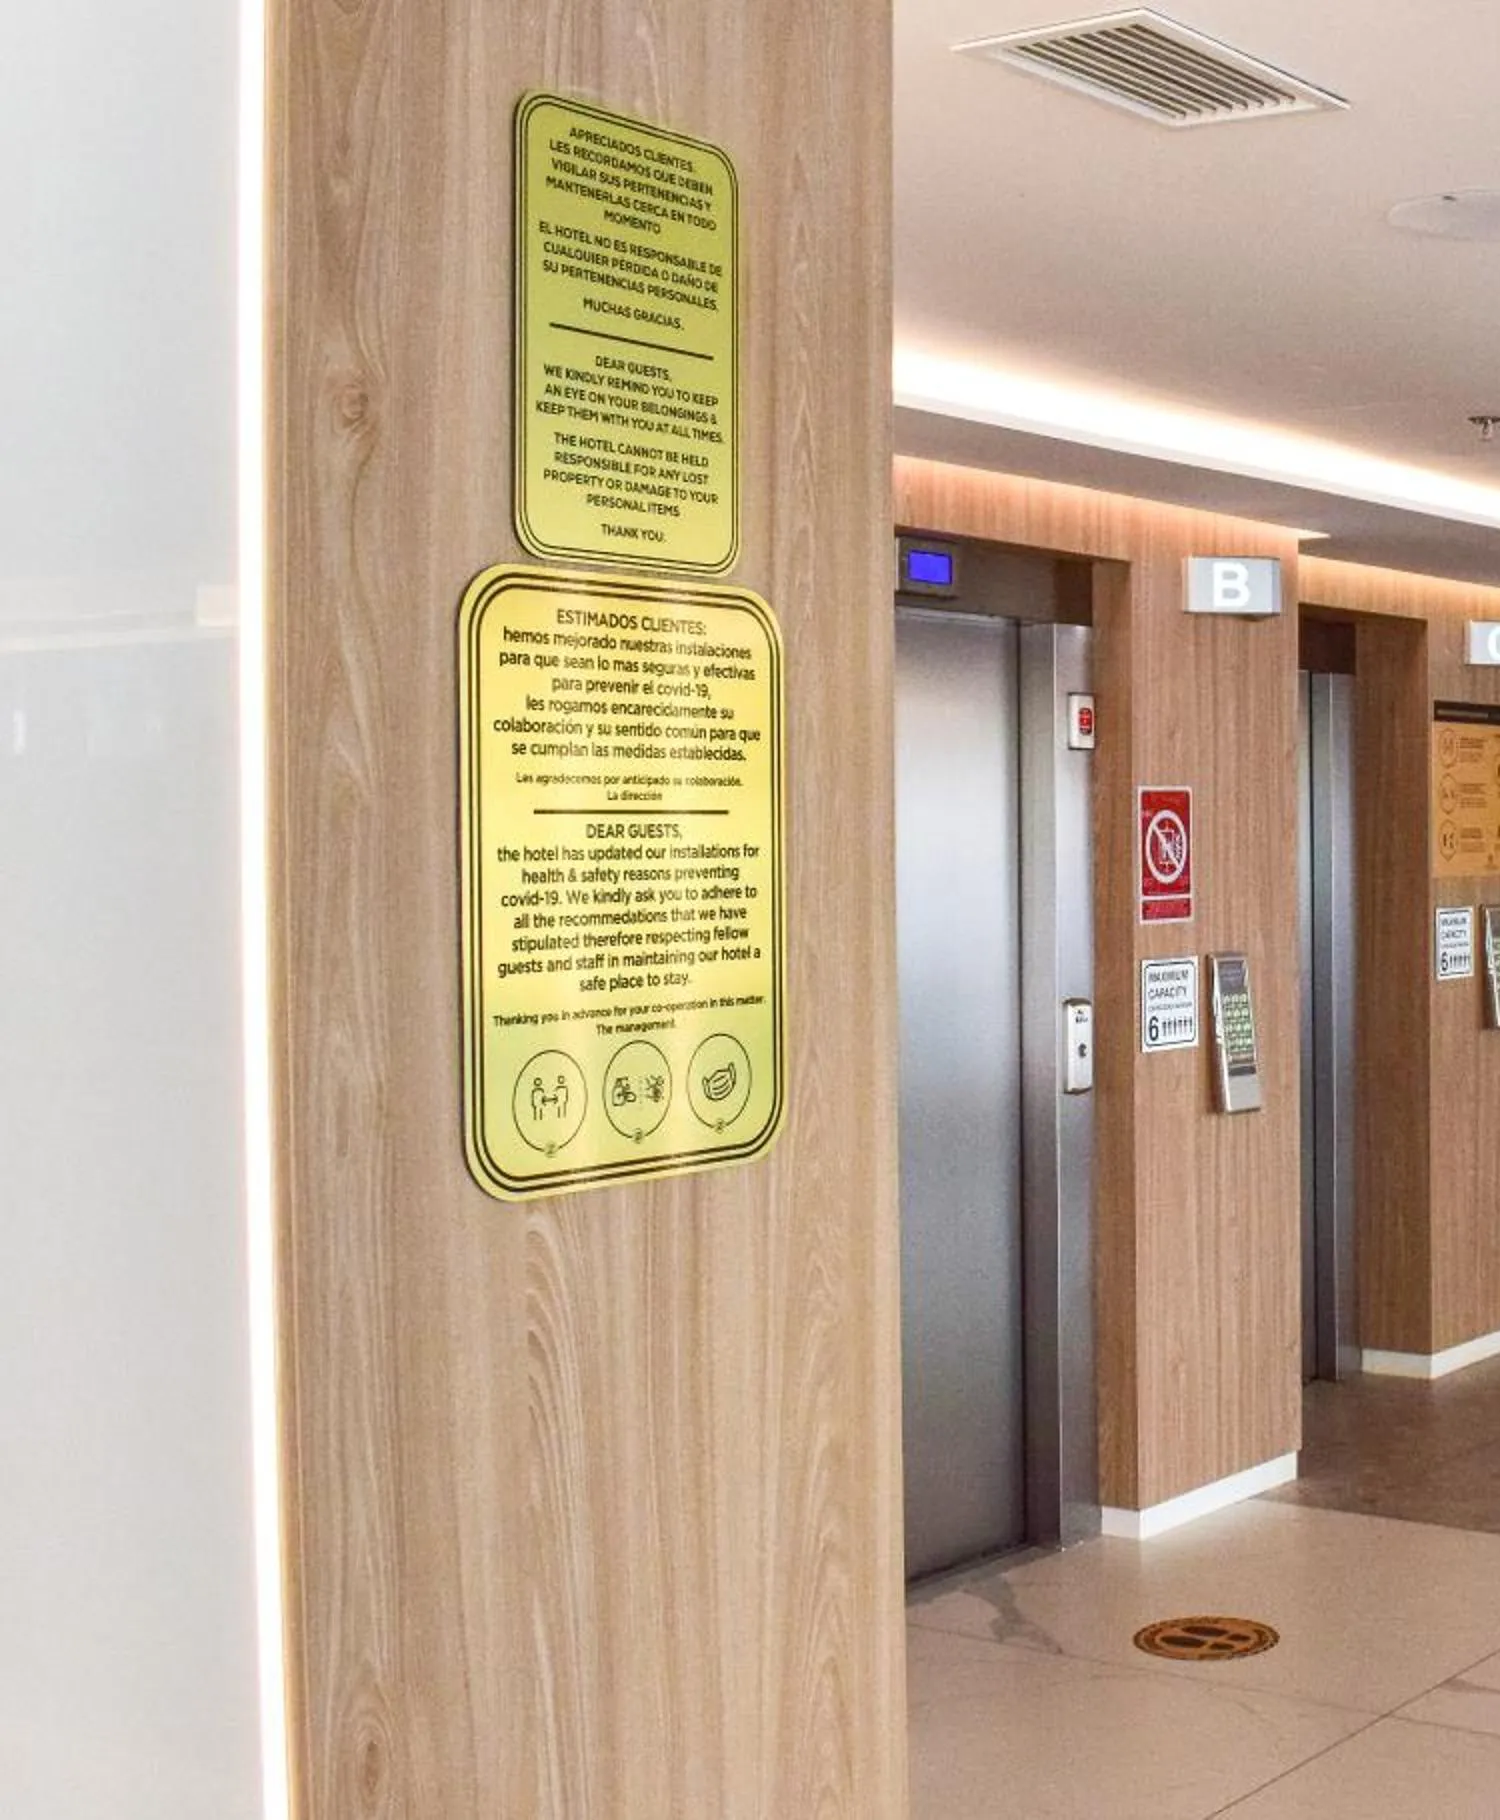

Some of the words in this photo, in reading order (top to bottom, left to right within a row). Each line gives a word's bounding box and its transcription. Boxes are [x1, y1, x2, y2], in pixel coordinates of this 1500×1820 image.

[549, 139, 571, 154] LES
[572, 146, 651, 177] RECORDAMOS
[651, 169, 676, 184] QUE
[676, 176, 713, 194] DEBEN
[552, 158, 597, 179] VIGILAR
[598, 171, 621, 187] SUS
[622, 179, 704, 209] PERTENENCIAS
[703, 200, 712, 211] Y
[546, 177, 631, 207] MANTENERLAS
[631, 199, 669, 217] CERCA
[668, 209, 686, 222] EN
[686, 213, 717, 230] TODO
[604, 210, 662, 233] MOMENTO
[539, 220, 552, 234] EL
[552, 225, 592, 244] HOTEL
[592, 235, 612, 248] NO
[612, 239, 628, 253] ES
[628, 244, 707, 271] RESPONSABLE
[707, 263, 723, 277] DE
[583, 298, 632, 317] MUCHAS
[632, 309, 684, 329] GRACIAS.
[595, 355, 626, 370] DEAR
[544, 364, 562, 378] WE
[564, 368, 606, 385] KINDLY
[606, 376, 651, 393] REMIND
[650, 384, 675, 399] YOU
[675, 389, 691, 402] TO
[690, 393, 718, 406] KEEP
[544, 383, 563, 396] AN
[562, 386, 586, 400] EYE
[587, 391, 607, 404] ON
[606, 394, 639, 410] YOUR
[639, 401, 709, 422] BELONGINGS
[709, 413, 717, 425] &
[536, 401, 566, 414] KEEP
[566, 405, 599, 421] THEM
[599, 412, 630, 426] WITH
[630, 417, 655, 431] YOU
[654, 421, 670, 433] AT
[669, 424, 690, 438] ALL
[555, 431, 577, 446] THE
[577, 436, 616, 452] HOTEL
[616, 443, 663, 459] CANNOT
[664, 450, 679, 463] BE
[680, 453, 709, 467] HELD
[553, 451, 632, 473] RESPONSIBLE
[632, 463, 657, 477] FOR
[657, 468, 681, 480] ANY
[680, 472, 709, 484] LOST
[544, 469, 604, 486] PROPERTY
[604, 477, 623, 490] OR
[623, 481, 672, 497] DAMAGE
[671, 487, 688, 500] TO
[688, 490, 718, 503] YOUR
[586, 493, 646, 512] PERSONAL
[601, 523, 639, 538] THANK
[1213, 562, 1250, 607] B
[556, 609, 638, 629] ESTIMADOS
[640, 616, 706, 634] CLIENTES:
[503, 627, 550, 644] hemos
[553, 634, 617, 649] mejorado
[619, 639, 672, 652] nuestras
[675, 643, 752, 659] instalaciones
[499, 652, 530, 665] para
[533, 654, 559, 668] que
[563, 656, 594, 668] sean
[596, 655, 610, 670] lo
[612, 659, 639, 672] mas
[641, 662, 689, 676] seguras
[693, 665, 700, 679] y
[702, 664, 755, 680] efectivas
[552, 677, 582, 691] para
[585, 679, 639, 693] prevenir
[641, 680, 654, 694] el
[656, 683, 711, 699] covid-19,
[526, 695, 545, 710] les
[548, 700, 608, 714] rogamos
[610, 703, 717, 717] encarecidamente
[719, 708, 734, 719] su
[493, 718, 583, 733] colaboración
[585, 723, 594, 738] y
[597, 723, 612, 735] su
[614, 723, 662, 736] sentido
[709, 728, 736, 741] para
[738, 729, 761, 742] que
[512, 743, 527, 754] se
[529, 743, 588, 756] cumplan
[591, 742, 609, 756] las
[611, 744, 666, 758] medidas
[669, 746, 746, 760] establecidas.
[586, 823, 625, 838] DEAR
[497, 847, 520, 861] the
[522, 846, 558, 860] hotel
[561, 847, 584, 860] has
[587, 845, 643, 860] updated
[645, 847, 665, 859] our
[669, 844, 740, 858] installations
[742, 843, 759, 857] for
[521, 868, 564, 883] health
[567, 867, 576, 882] &
[580, 867, 620, 883] safety
[622, 869, 671, 880] reasons
[674, 866, 740, 880] preventing
[501, 890, 561, 906] covid-19.
[565, 890, 589, 904] We
[592, 888, 631, 904] kindly
[634, 888, 655, 902] ask
[658, 889, 682, 904] you
[684, 887, 698, 900] to
[700, 886, 742, 899] adhere
[744, 885, 757, 898] to
[514, 913, 530, 928] all
[532, 913, 555, 928] the
[670, 908, 695, 921] that
[698, 909, 716, 920] we
[718, 906, 747, 919] have
[512, 935, 579, 952] stipulated
[582, 932, 643, 946] therefore
[645, 929, 711, 944] respecting
[712, 926, 749, 939] fellow
[498, 960, 543, 977] guests
[546, 957, 572, 972] and
[575, 953, 604, 969] staff
[607, 954, 619, 967] in
[621, 951, 695, 966] maintaining
[697, 950, 718, 962] our
[720, 946, 751, 960] hotel
[752, 947, 761, 958] a
[580, 976, 606, 991] safe
[608, 975, 644, 991] place
[646, 973, 660, 986] to
[663, 972, 690, 985] stay.
[1149, 1016, 1159, 1041] 6
